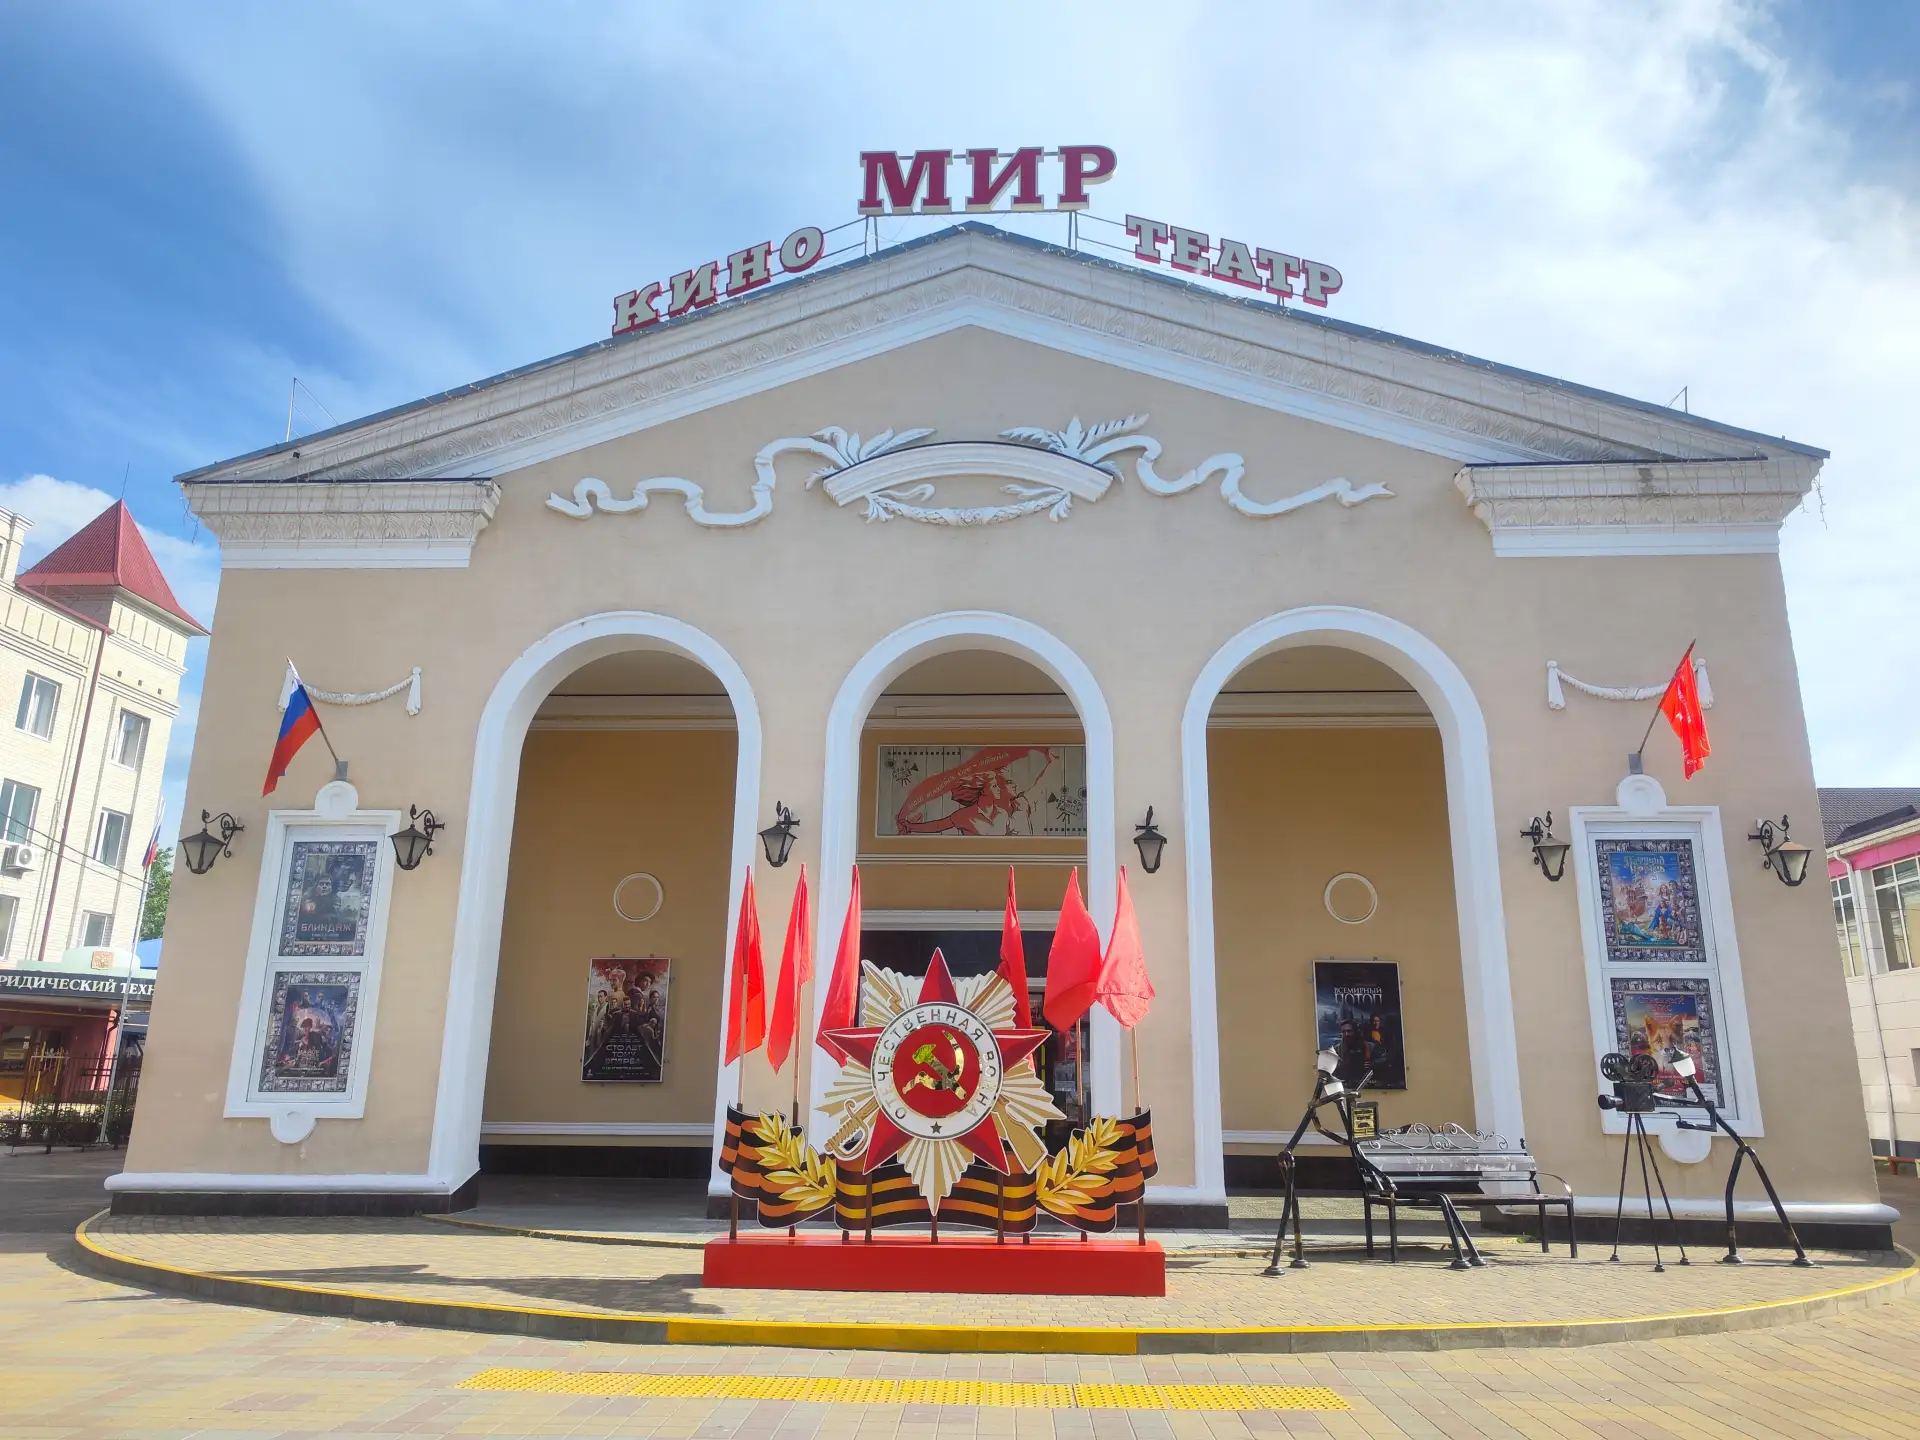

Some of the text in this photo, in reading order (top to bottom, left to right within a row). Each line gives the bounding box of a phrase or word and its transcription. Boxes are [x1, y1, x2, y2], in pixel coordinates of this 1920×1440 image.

[858, 145, 1117, 215] МИР
[612, 226, 825, 336] КИНО
[1125, 214, 1344, 308] ТЕАТР
[300, 923, 352, 933] БЛИНДАЖ
[1334, 986, 1382, 994] ВСЕМИРНЫЙ
[1334, 993, 1383, 1004] ПОТОП
